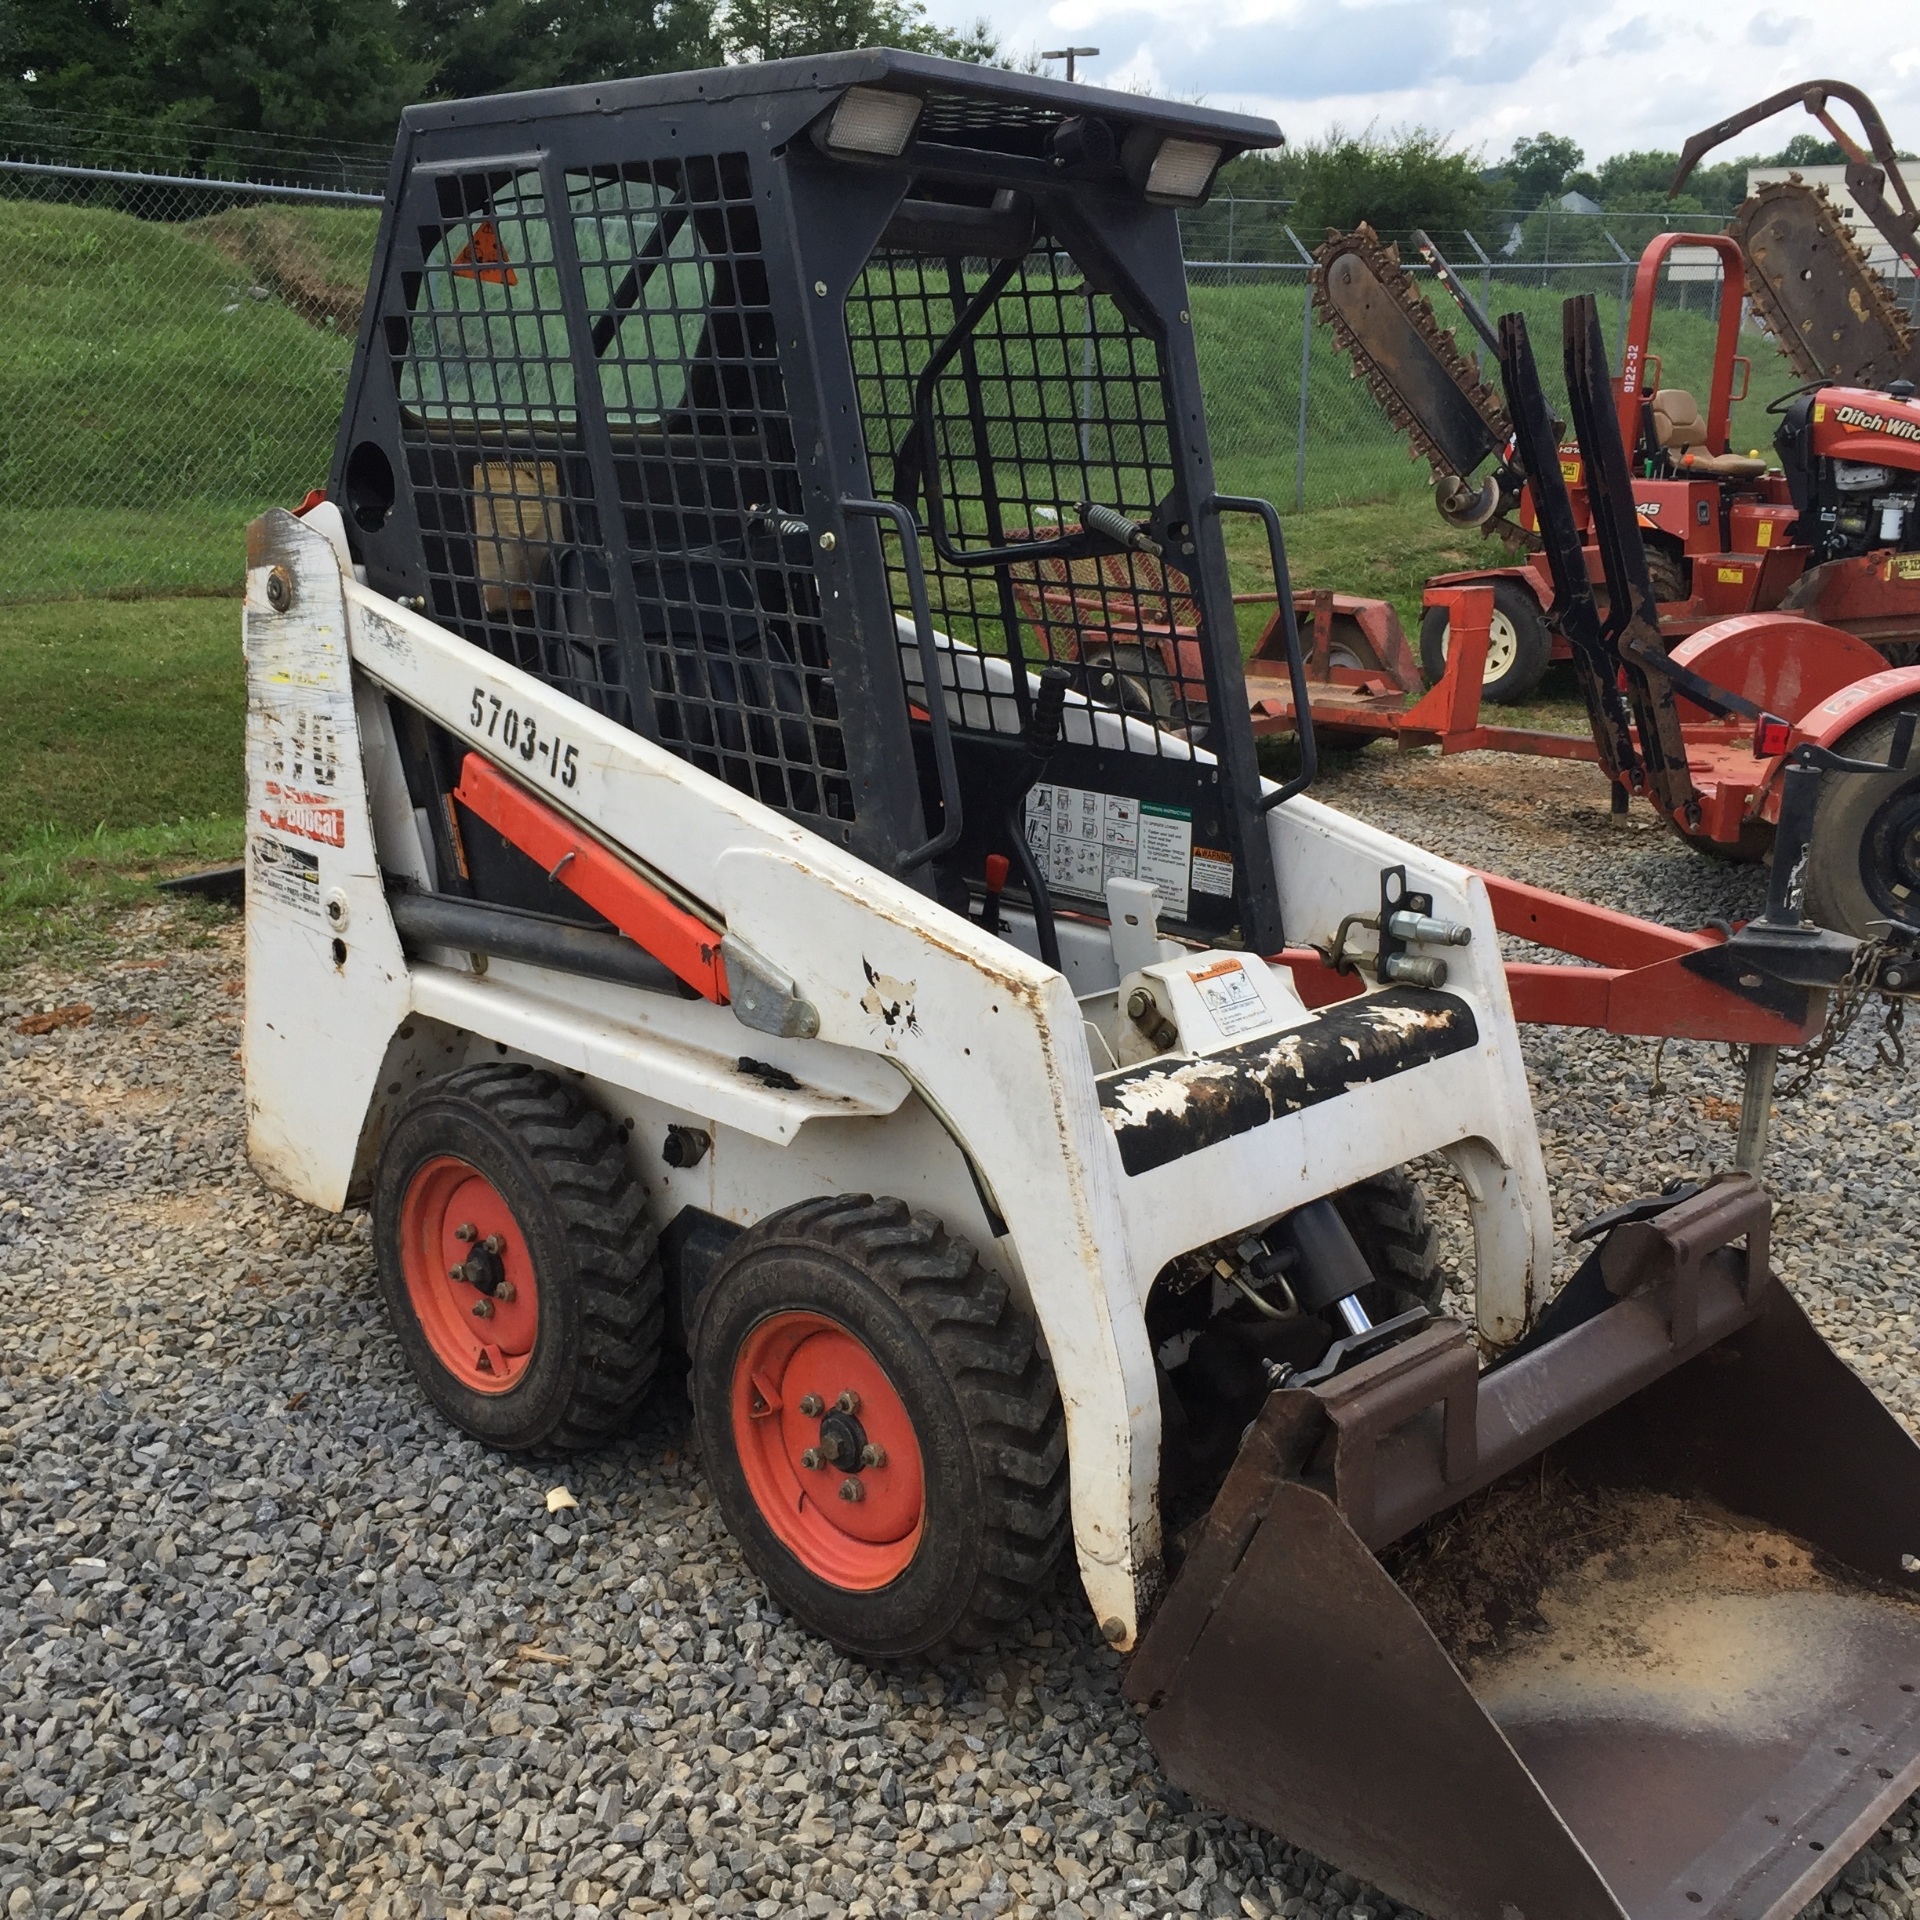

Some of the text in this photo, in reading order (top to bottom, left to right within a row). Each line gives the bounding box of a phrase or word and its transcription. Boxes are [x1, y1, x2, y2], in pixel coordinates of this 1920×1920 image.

[1623, 345, 1639, 393] 9122-32
[1836, 406, 1884, 431] Ditch
[1635, 503, 1661, 515] 45
[470, 687, 579, 788] 5703-15
[286, 809, 338, 839] Bobcat
[1200, 848, 1232, 862] WARNING
